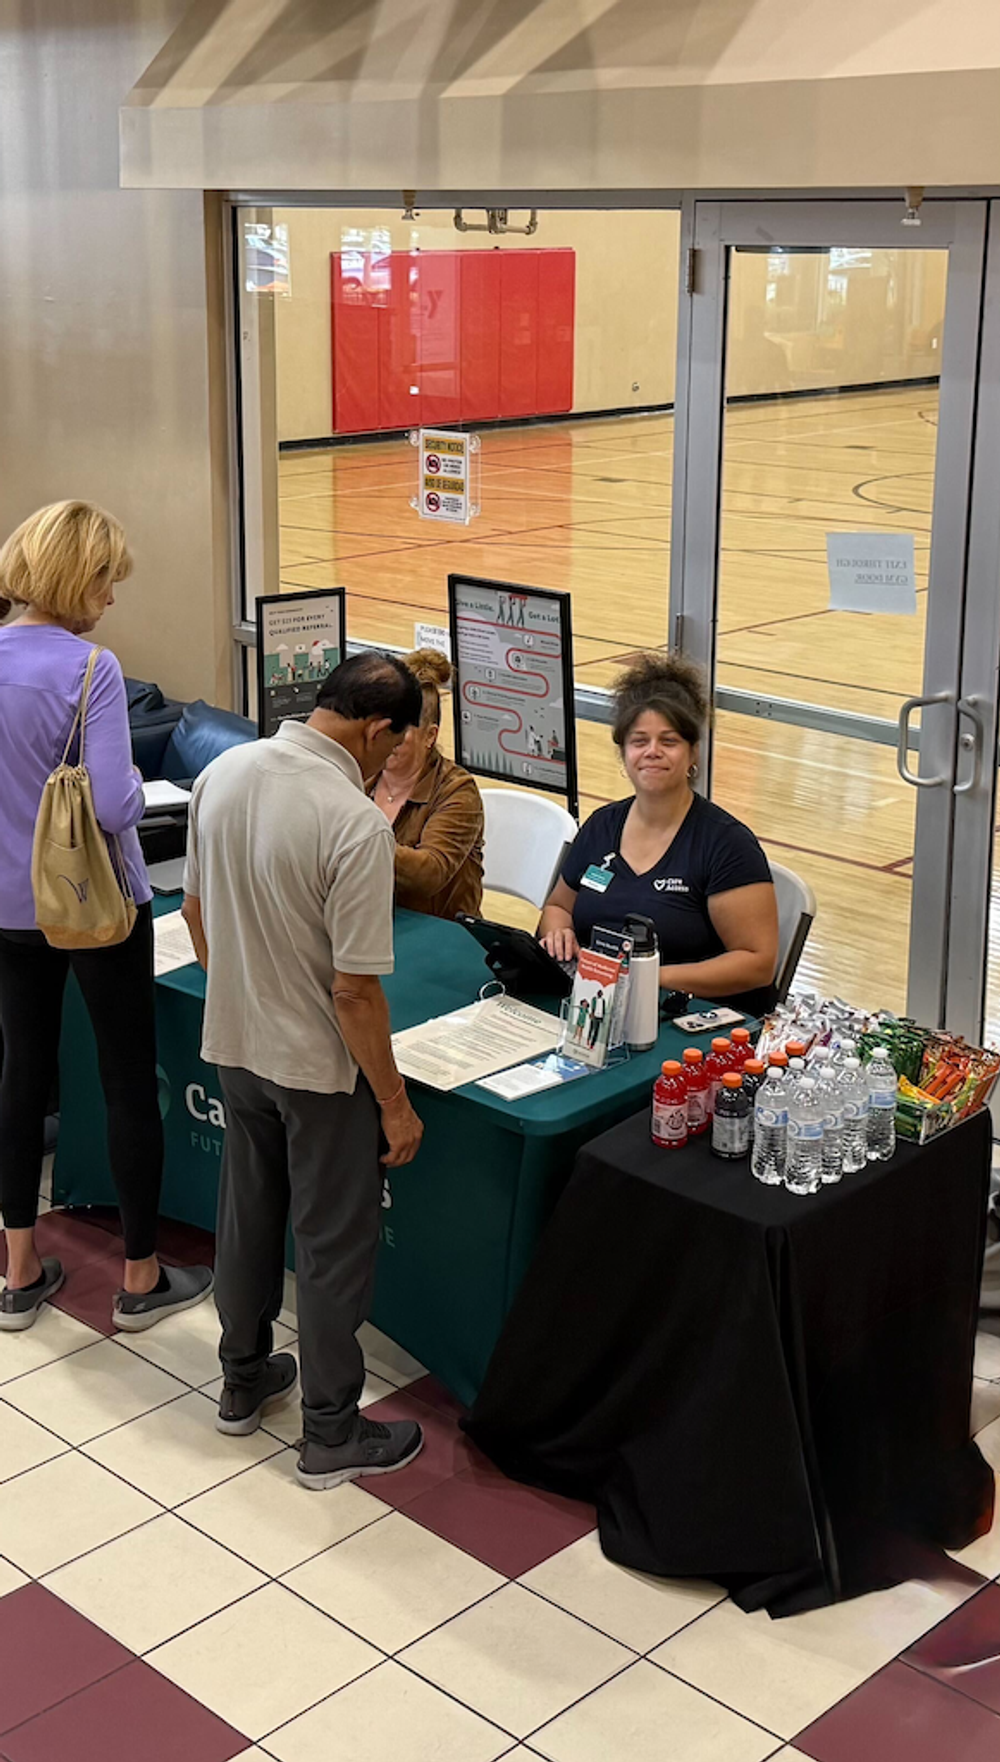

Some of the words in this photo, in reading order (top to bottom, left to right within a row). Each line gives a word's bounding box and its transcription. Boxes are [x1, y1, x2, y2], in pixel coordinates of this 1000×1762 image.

[424, 438, 446, 451] SECURITY
[447, 441, 464, 454] NOTICE
[497, 1000, 543, 1025] Welcome
[185, 1082, 227, 1129] Ca
